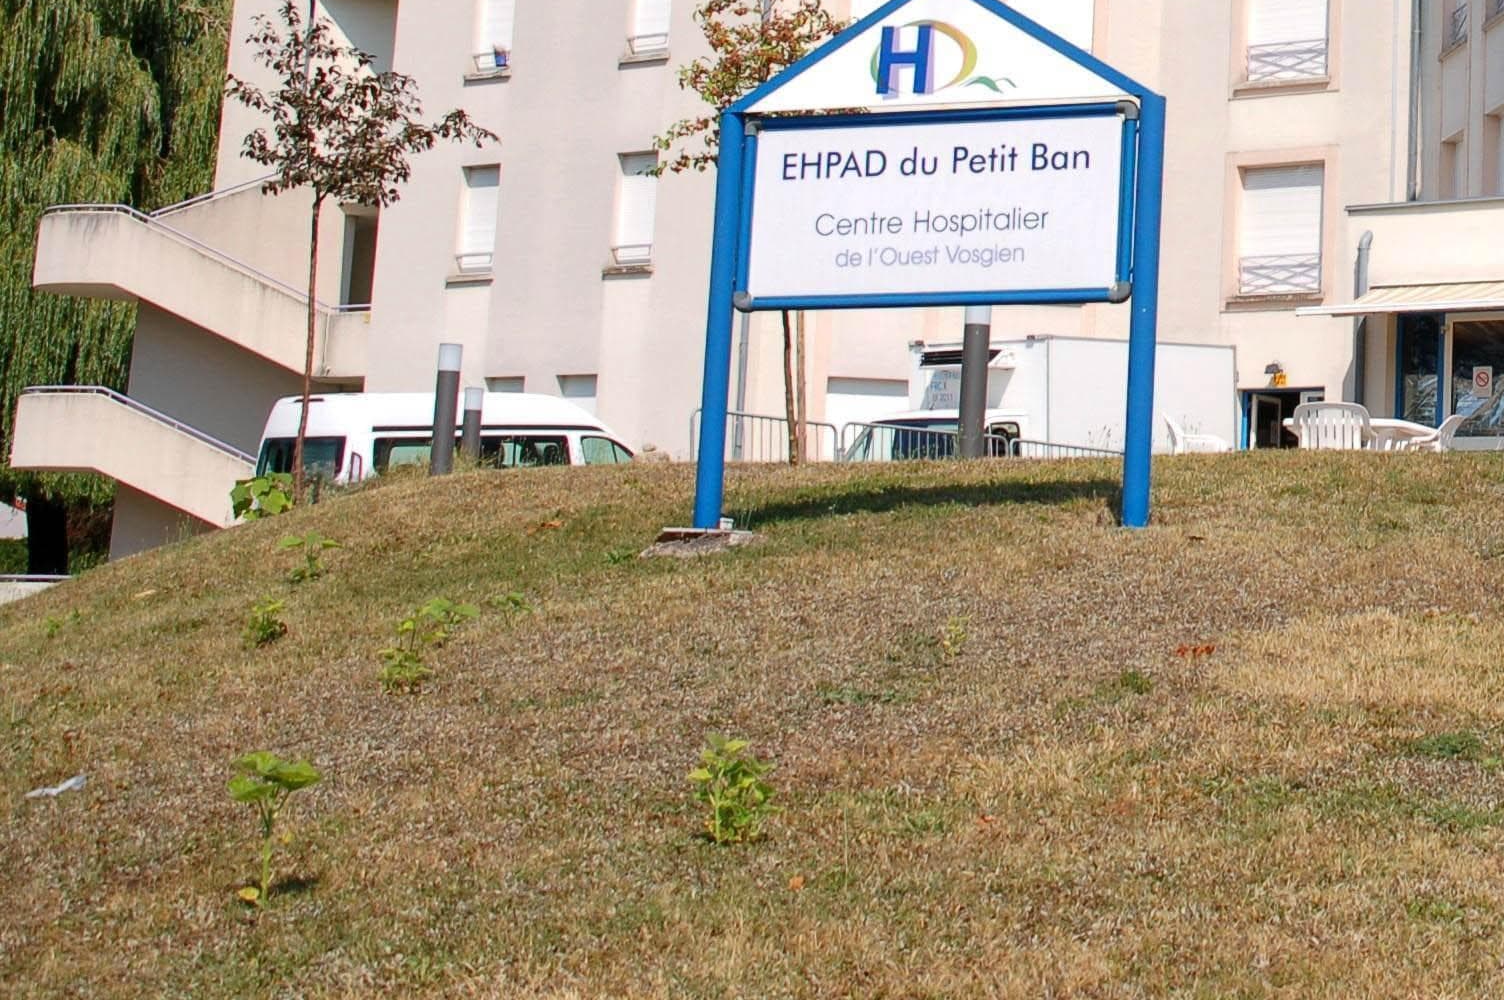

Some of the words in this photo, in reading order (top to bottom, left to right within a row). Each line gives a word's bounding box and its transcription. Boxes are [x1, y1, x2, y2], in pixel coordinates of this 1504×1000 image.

[782, 149, 888, 181] EHPAD
[899, 145, 939, 177] du
[952, 143, 1019, 175] Petit
[1030, 142, 1091, 172] Ban
[814, 210, 903, 237] Centre
[913, 206, 1049, 238] Hospitalier
[834, 248, 863, 269] de
[867, 245, 940, 268] l'Ouest
[945, 243, 1026, 269] Vosgien
